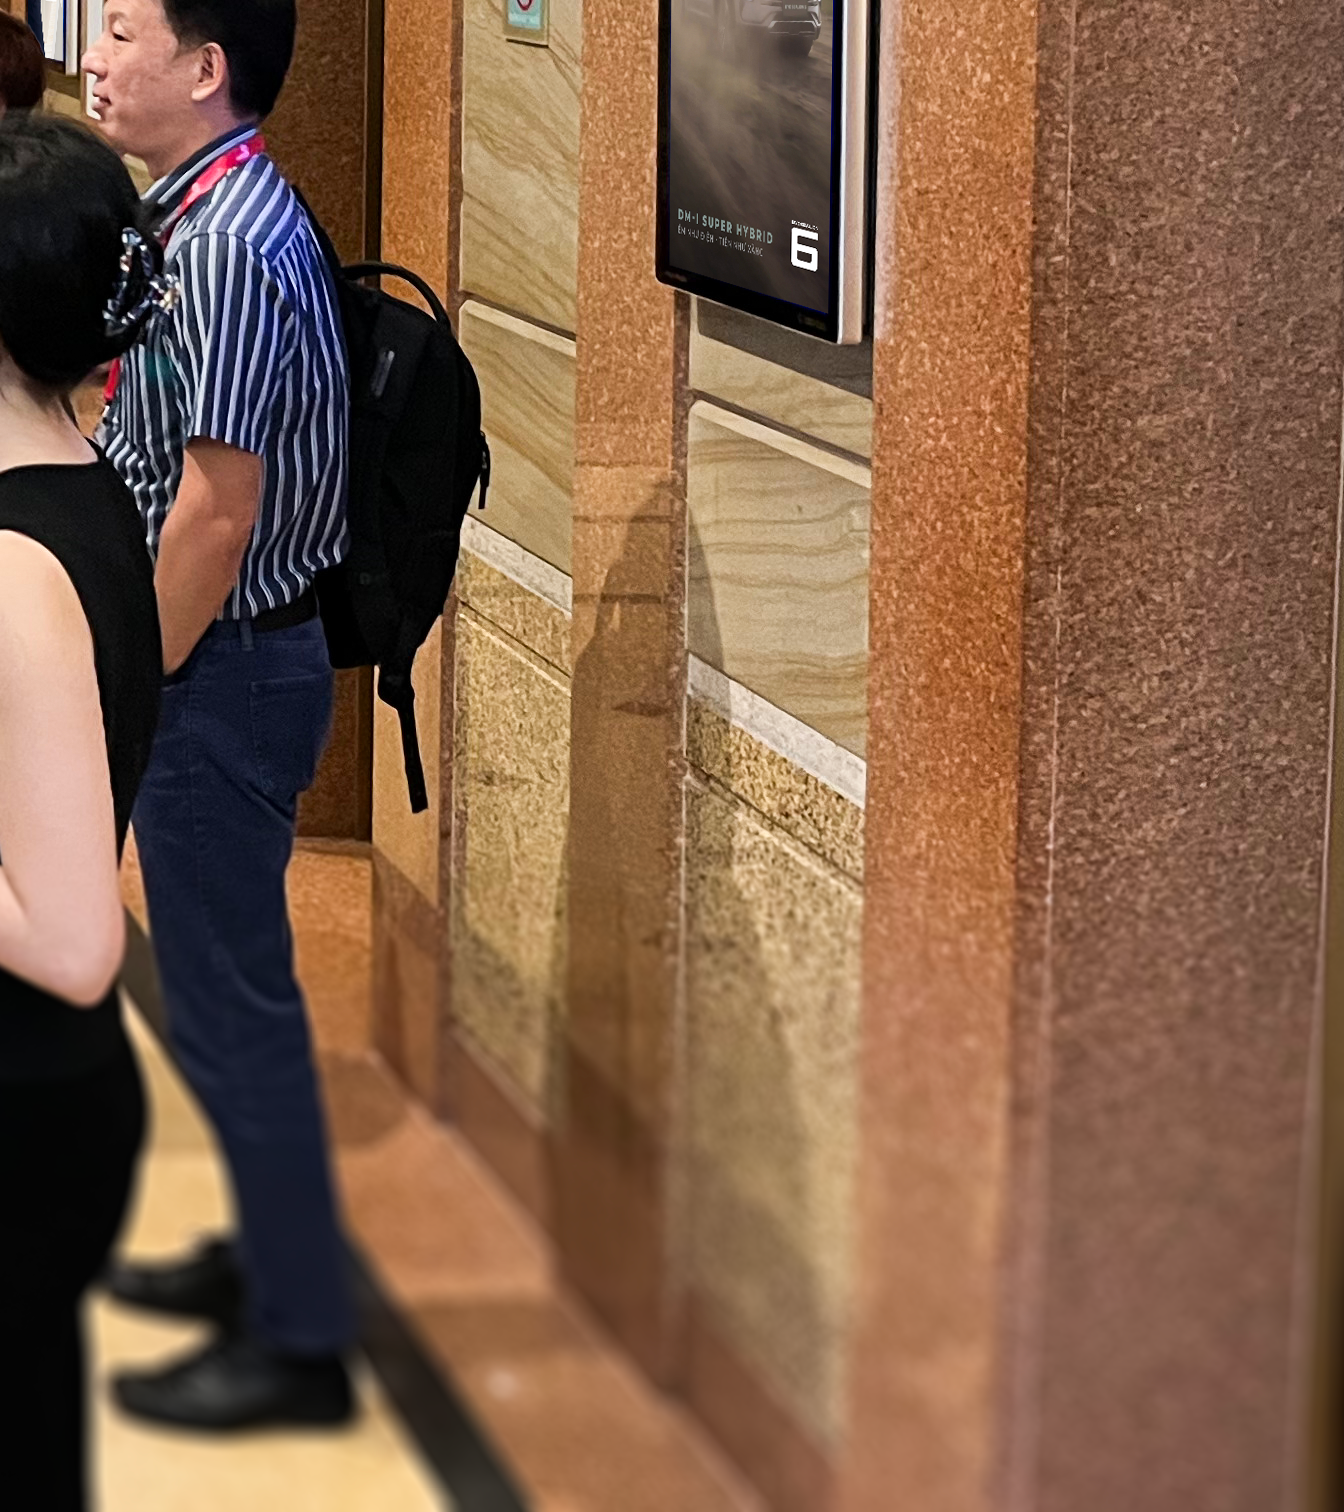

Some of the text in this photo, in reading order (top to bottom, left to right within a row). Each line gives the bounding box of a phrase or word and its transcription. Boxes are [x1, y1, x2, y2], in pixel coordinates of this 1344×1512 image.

[702, 215, 732, 234] SUPER
[736, 223, 773, 244] HYBRID
[791, 227, 819, 272] 6
